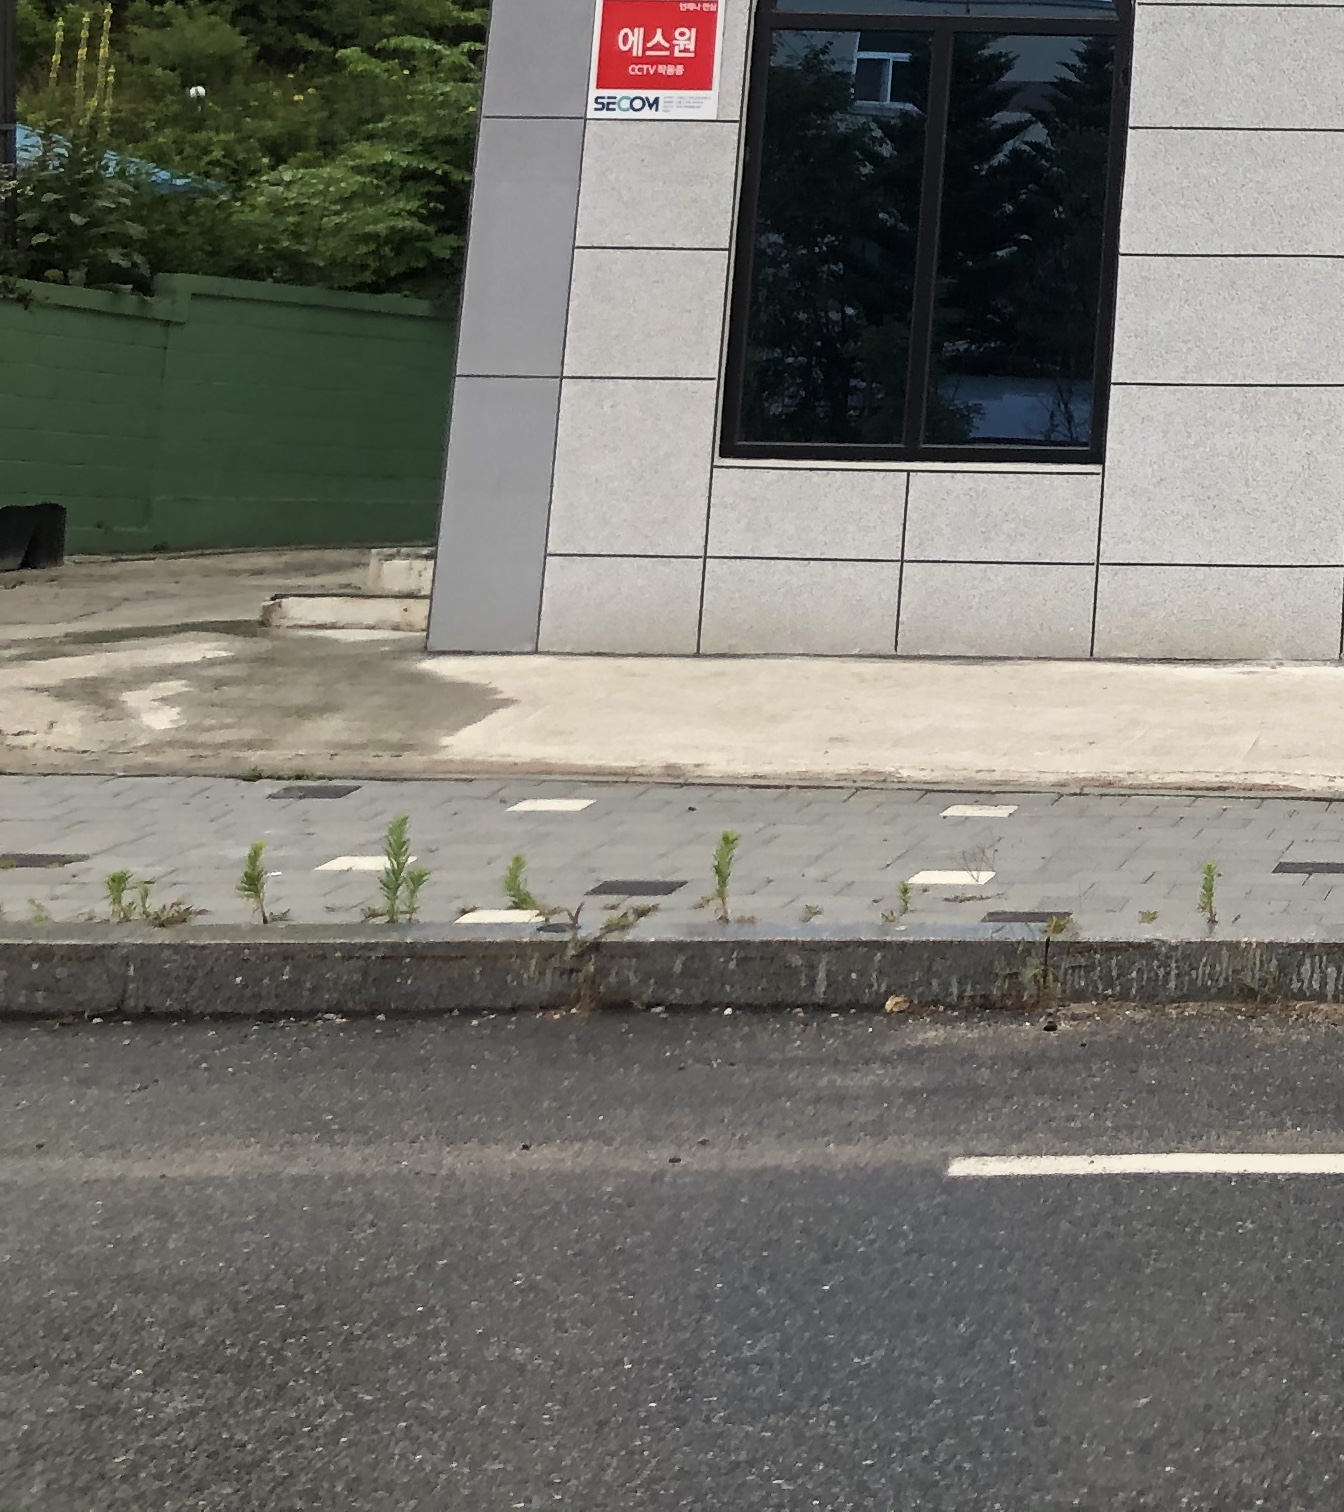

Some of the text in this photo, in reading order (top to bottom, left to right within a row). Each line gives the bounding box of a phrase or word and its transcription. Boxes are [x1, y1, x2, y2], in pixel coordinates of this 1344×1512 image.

[617, 26, 698, 58] 에스원
[628, 63, 657, 76] CCTV
[593, 95, 661, 112] SECOM
